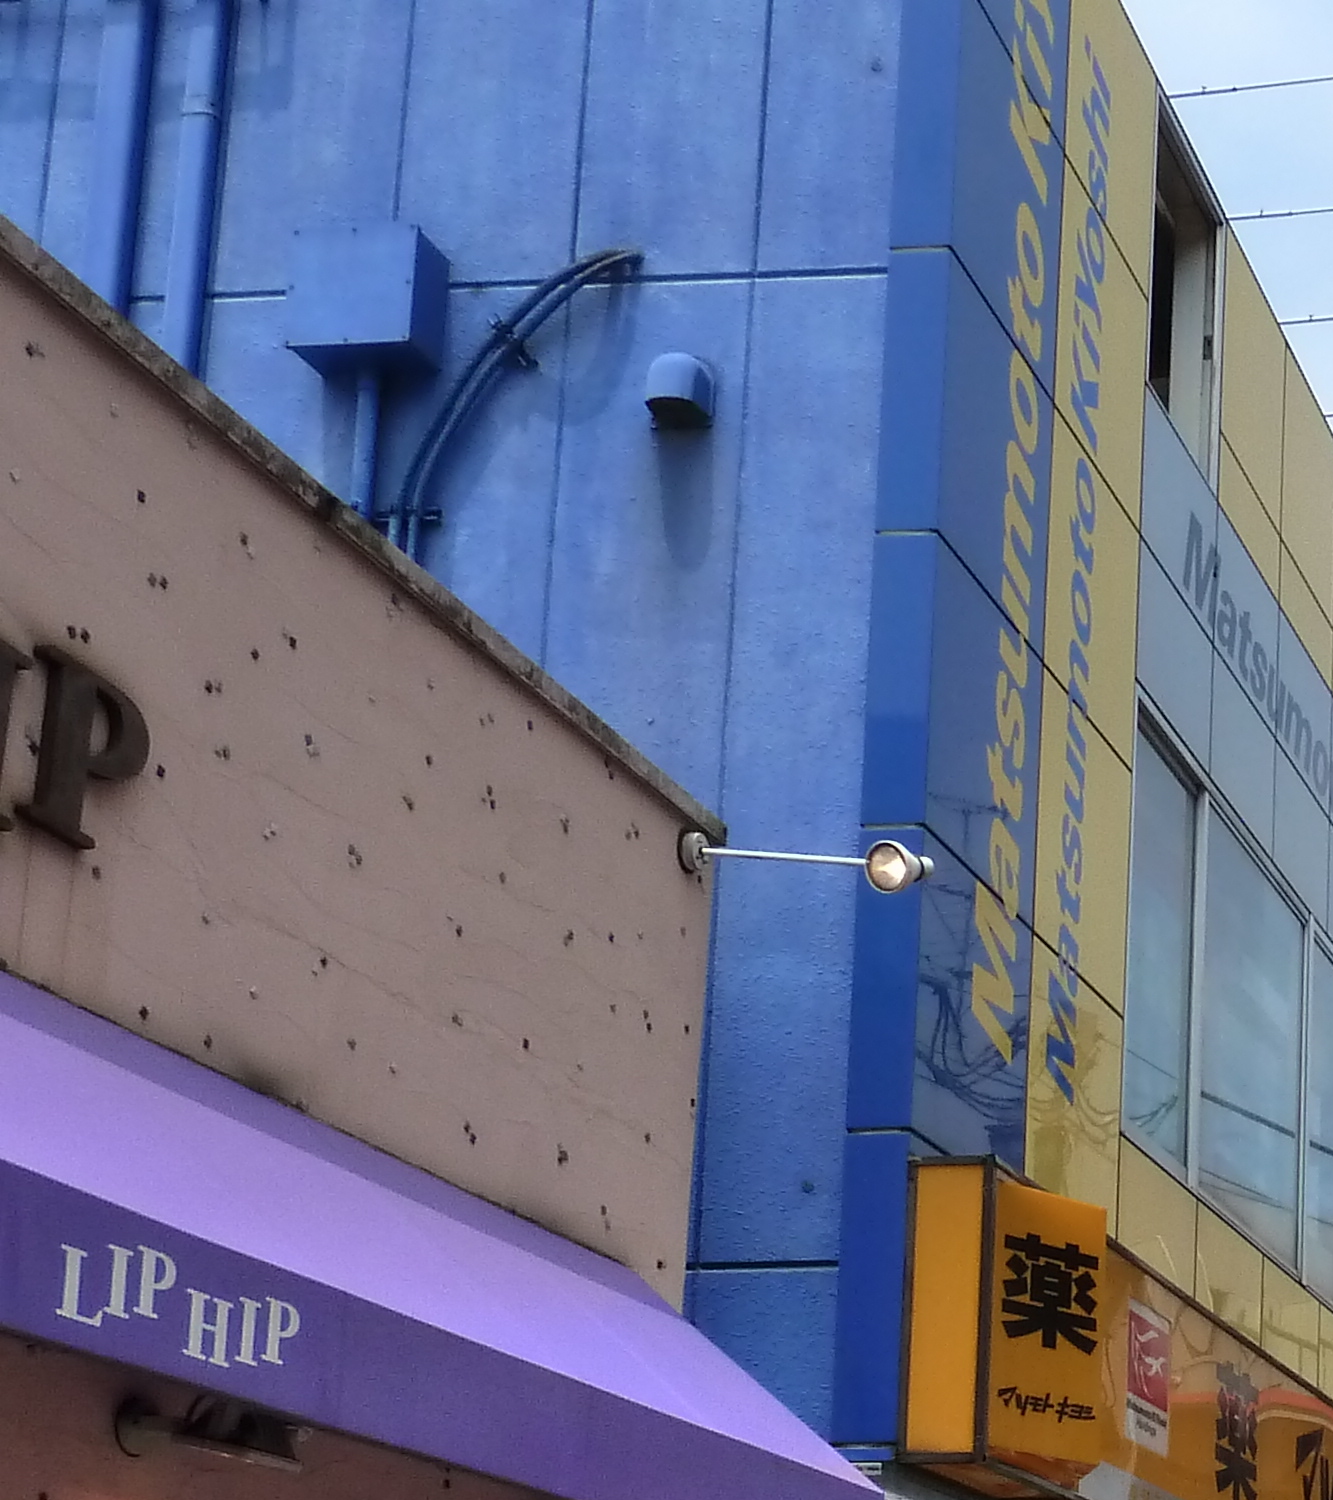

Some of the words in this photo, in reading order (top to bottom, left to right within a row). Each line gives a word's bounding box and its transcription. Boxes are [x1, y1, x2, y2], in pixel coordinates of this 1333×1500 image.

[971, 202, 1046, 1065] Matsumoto
[1046, 458, 1098, 1106] Matsumoto
[55, 1243, 178, 1328] LIP
[182, 1288, 301, 1368] HIP
[1001, 1232, 1099, 1356] 薬
[997, 1385, 1096, 1424] マツモトキヨシ
